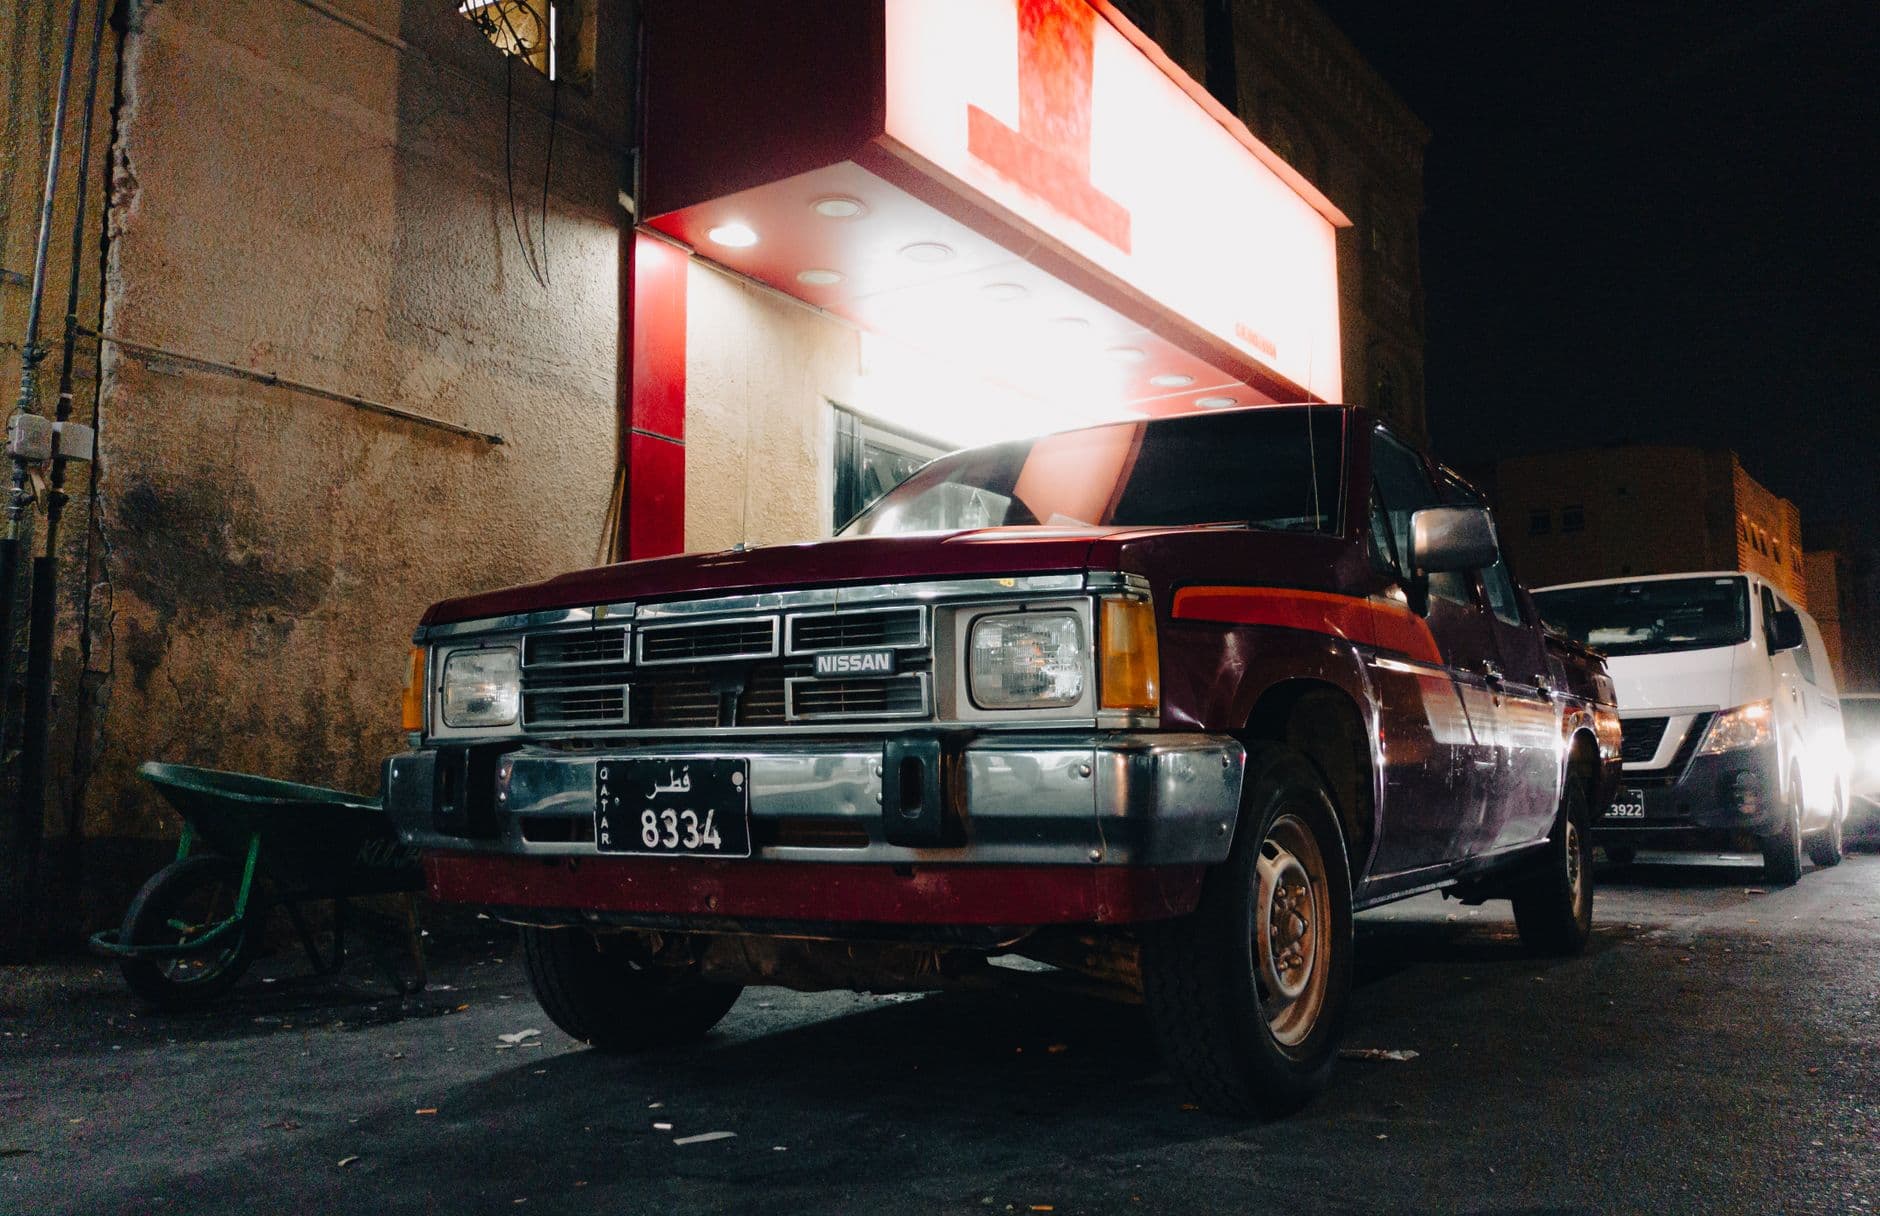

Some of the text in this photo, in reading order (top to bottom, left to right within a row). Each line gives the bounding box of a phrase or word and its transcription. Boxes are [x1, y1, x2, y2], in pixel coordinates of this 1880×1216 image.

[817, 653, 890, 673] NISSAN
[646, 765, 691, 800] قطر
[600, 767, 611, 845] QATAR
[1605, 804, 1642, 817] 3922
[641, 808, 722, 850] 8334
